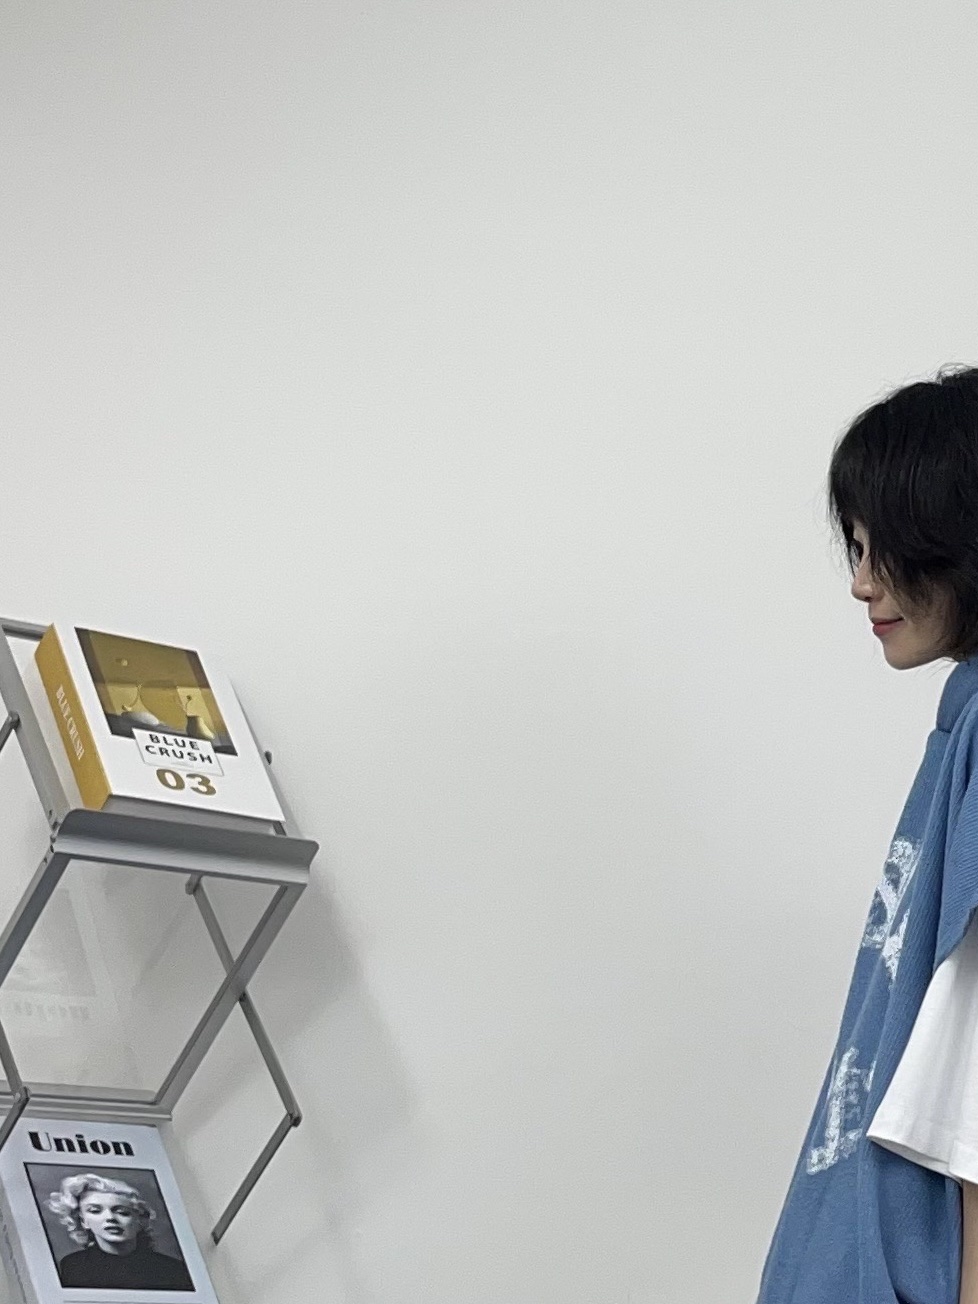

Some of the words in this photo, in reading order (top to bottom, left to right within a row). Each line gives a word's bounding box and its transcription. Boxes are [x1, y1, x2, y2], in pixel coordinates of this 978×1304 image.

[149, 733, 200, 751] BLUE
[145, 745, 213, 764] CRUSH
[156, 768, 217, 796] 03
[28, 1131, 135, 1157] Union
